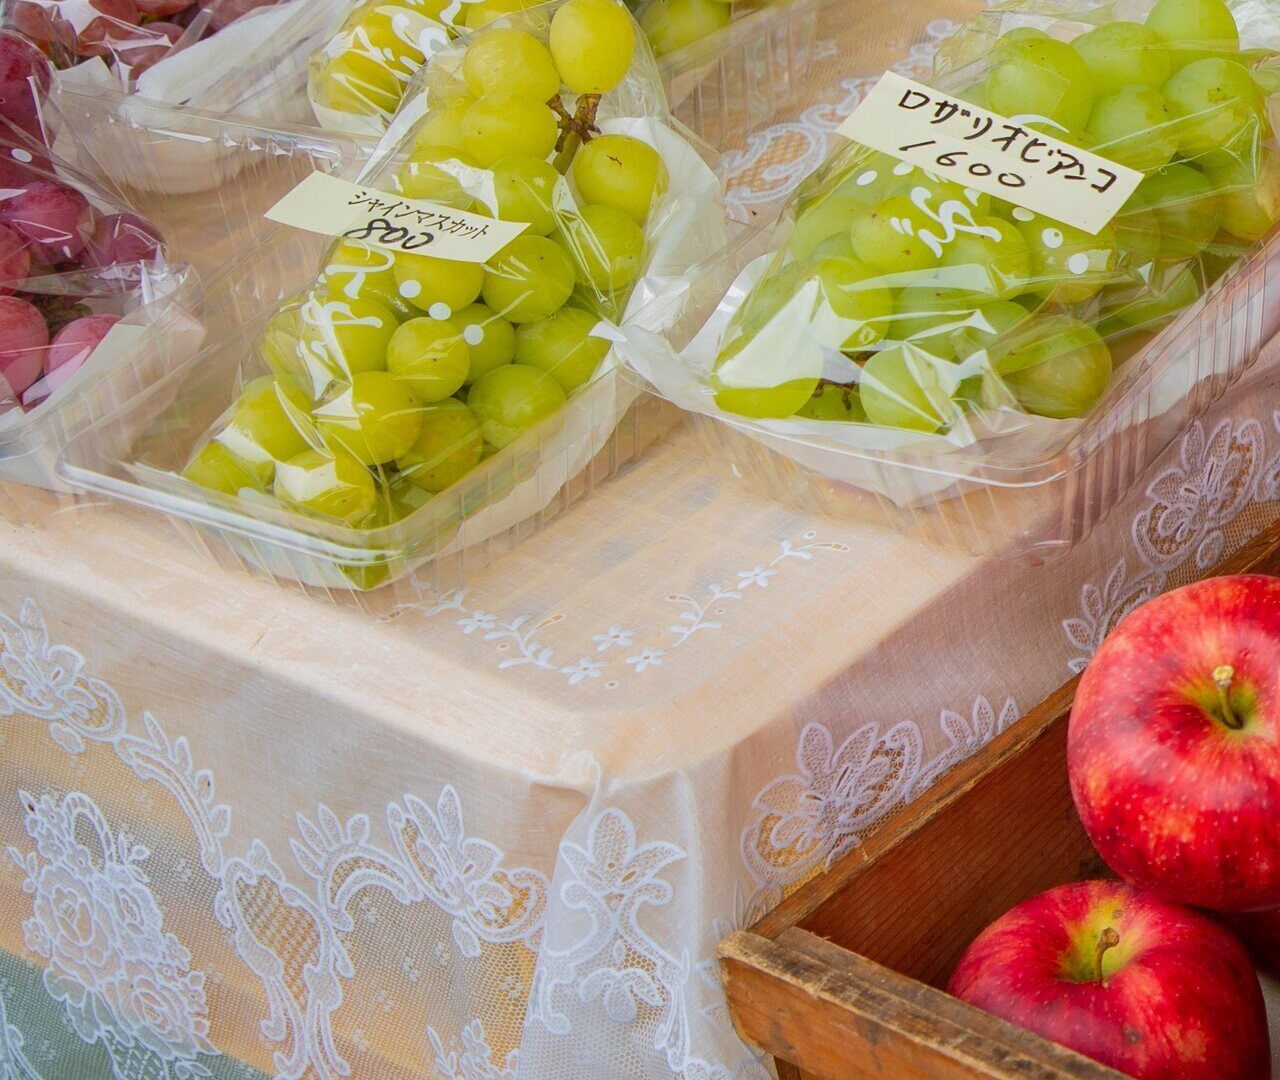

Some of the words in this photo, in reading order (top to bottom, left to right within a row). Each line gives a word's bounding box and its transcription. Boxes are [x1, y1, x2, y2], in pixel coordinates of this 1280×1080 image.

[897, 88, 1118, 194] ロザリオビアンコ
[898, 139, 1026, 189] 1600
[341, 218, 436, 251] 800
[347, 190, 491, 241] シャインマスカット
